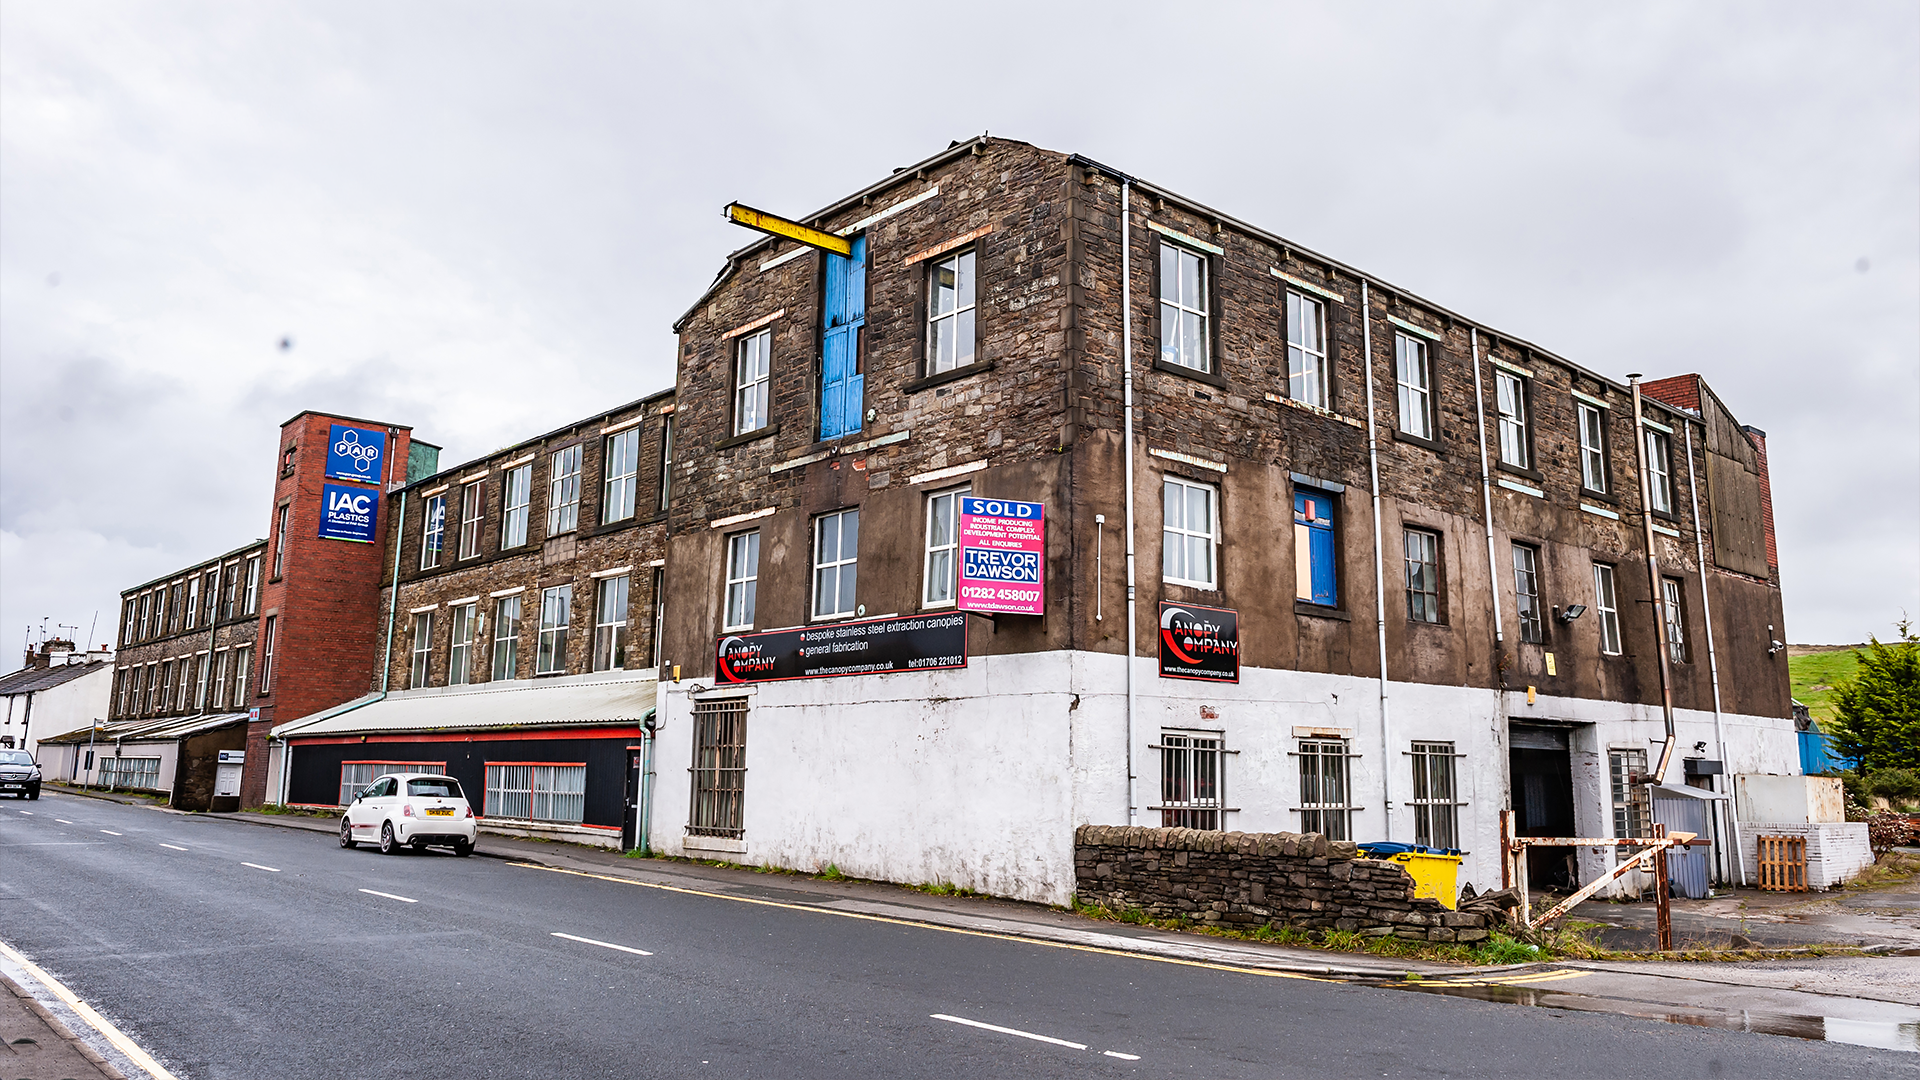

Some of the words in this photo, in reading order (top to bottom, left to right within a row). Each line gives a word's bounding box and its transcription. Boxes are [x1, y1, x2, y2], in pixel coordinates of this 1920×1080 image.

[338, 444, 375, 457] PAR
[329, 491, 371, 514] IAC
[972, 500, 1032, 517] SOLD
[328, 511, 369, 523] PLASTICS
[972, 517, 996, 525] INCOME
[998, 519, 1033, 527] PRODUCING
[963, 529, 1007, 538] DEVELOPMENT
[1008, 533, 1041, 541] POTENTIAL
[970, 523, 1004, 532] INDUSTRIAL
[1006, 526, 1035, 534] COMPLEX
[992, 540, 1022, 548] ENQUIRIES
[966, 550, 1036, 567] TREVOR
[966, 563, 1037, 580] DAWSON
[961, 586, 996, 599] 01282
[997, 589, 1040, 602] 458007
[967, 602, 1035, 611] www.tdawson.co.uk
[806, 628, 835, 643] bespoke
[836, 625, 866, 639] stainless
[867, 622, 885, 634] steel
[887, 618, 925, 633] extraction
[926, 614, 964, 631] canopies
[805, 643, 831, 658] general
[832, 640, 869, 653] fabrication
[805, 661, 894, 676] www.thecanopycompany.co.uk
[908, 657, 938, 668] tel:01706
[938, 655, 963, 666] 221012
